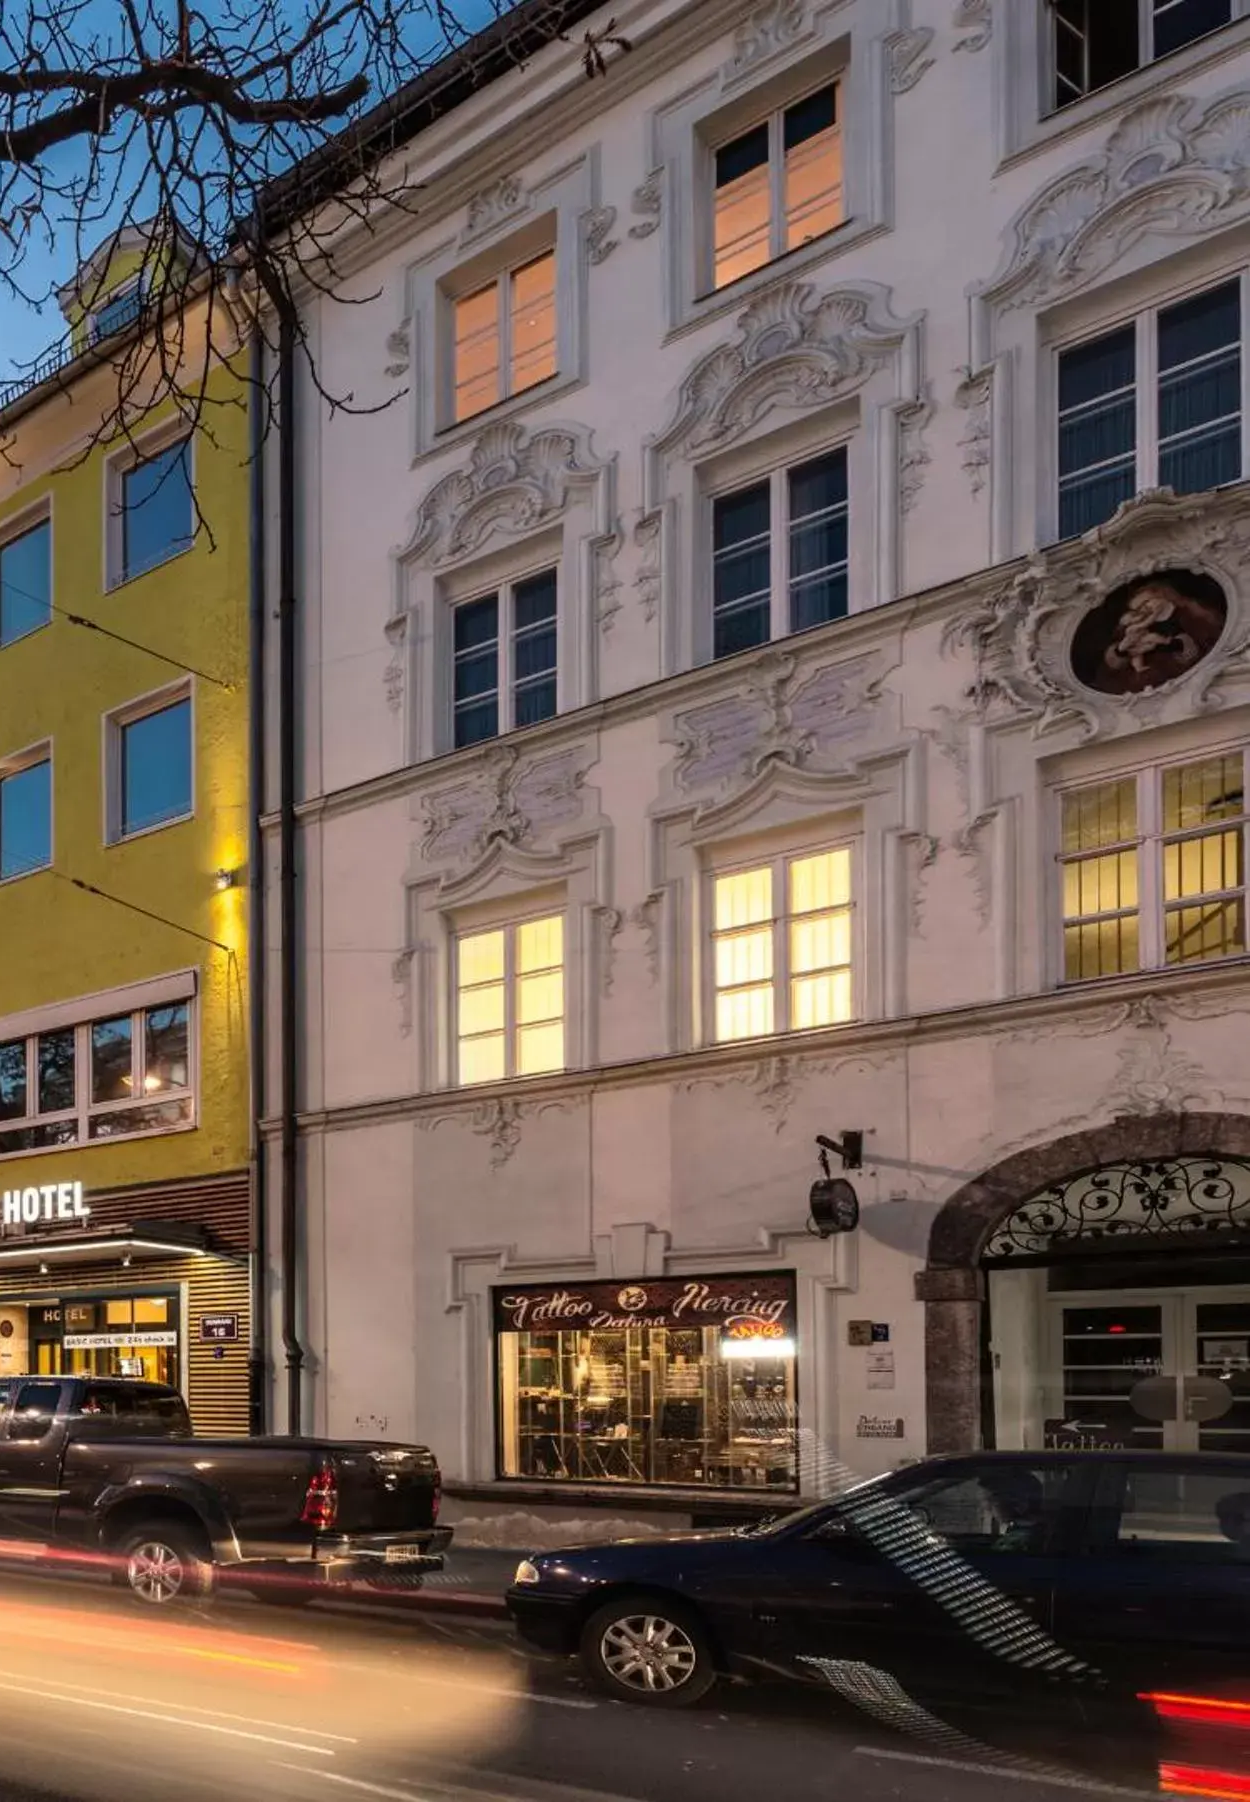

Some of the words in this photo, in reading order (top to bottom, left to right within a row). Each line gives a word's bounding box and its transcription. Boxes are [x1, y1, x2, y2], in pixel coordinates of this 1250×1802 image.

[2, 1181, 90, 1224] HOTEL
[44, 1308, 87, 1321] HOTEL
[502, 1290, 593, 1329] Tattoo
[673, 1282, 789, 1327] Piercing
